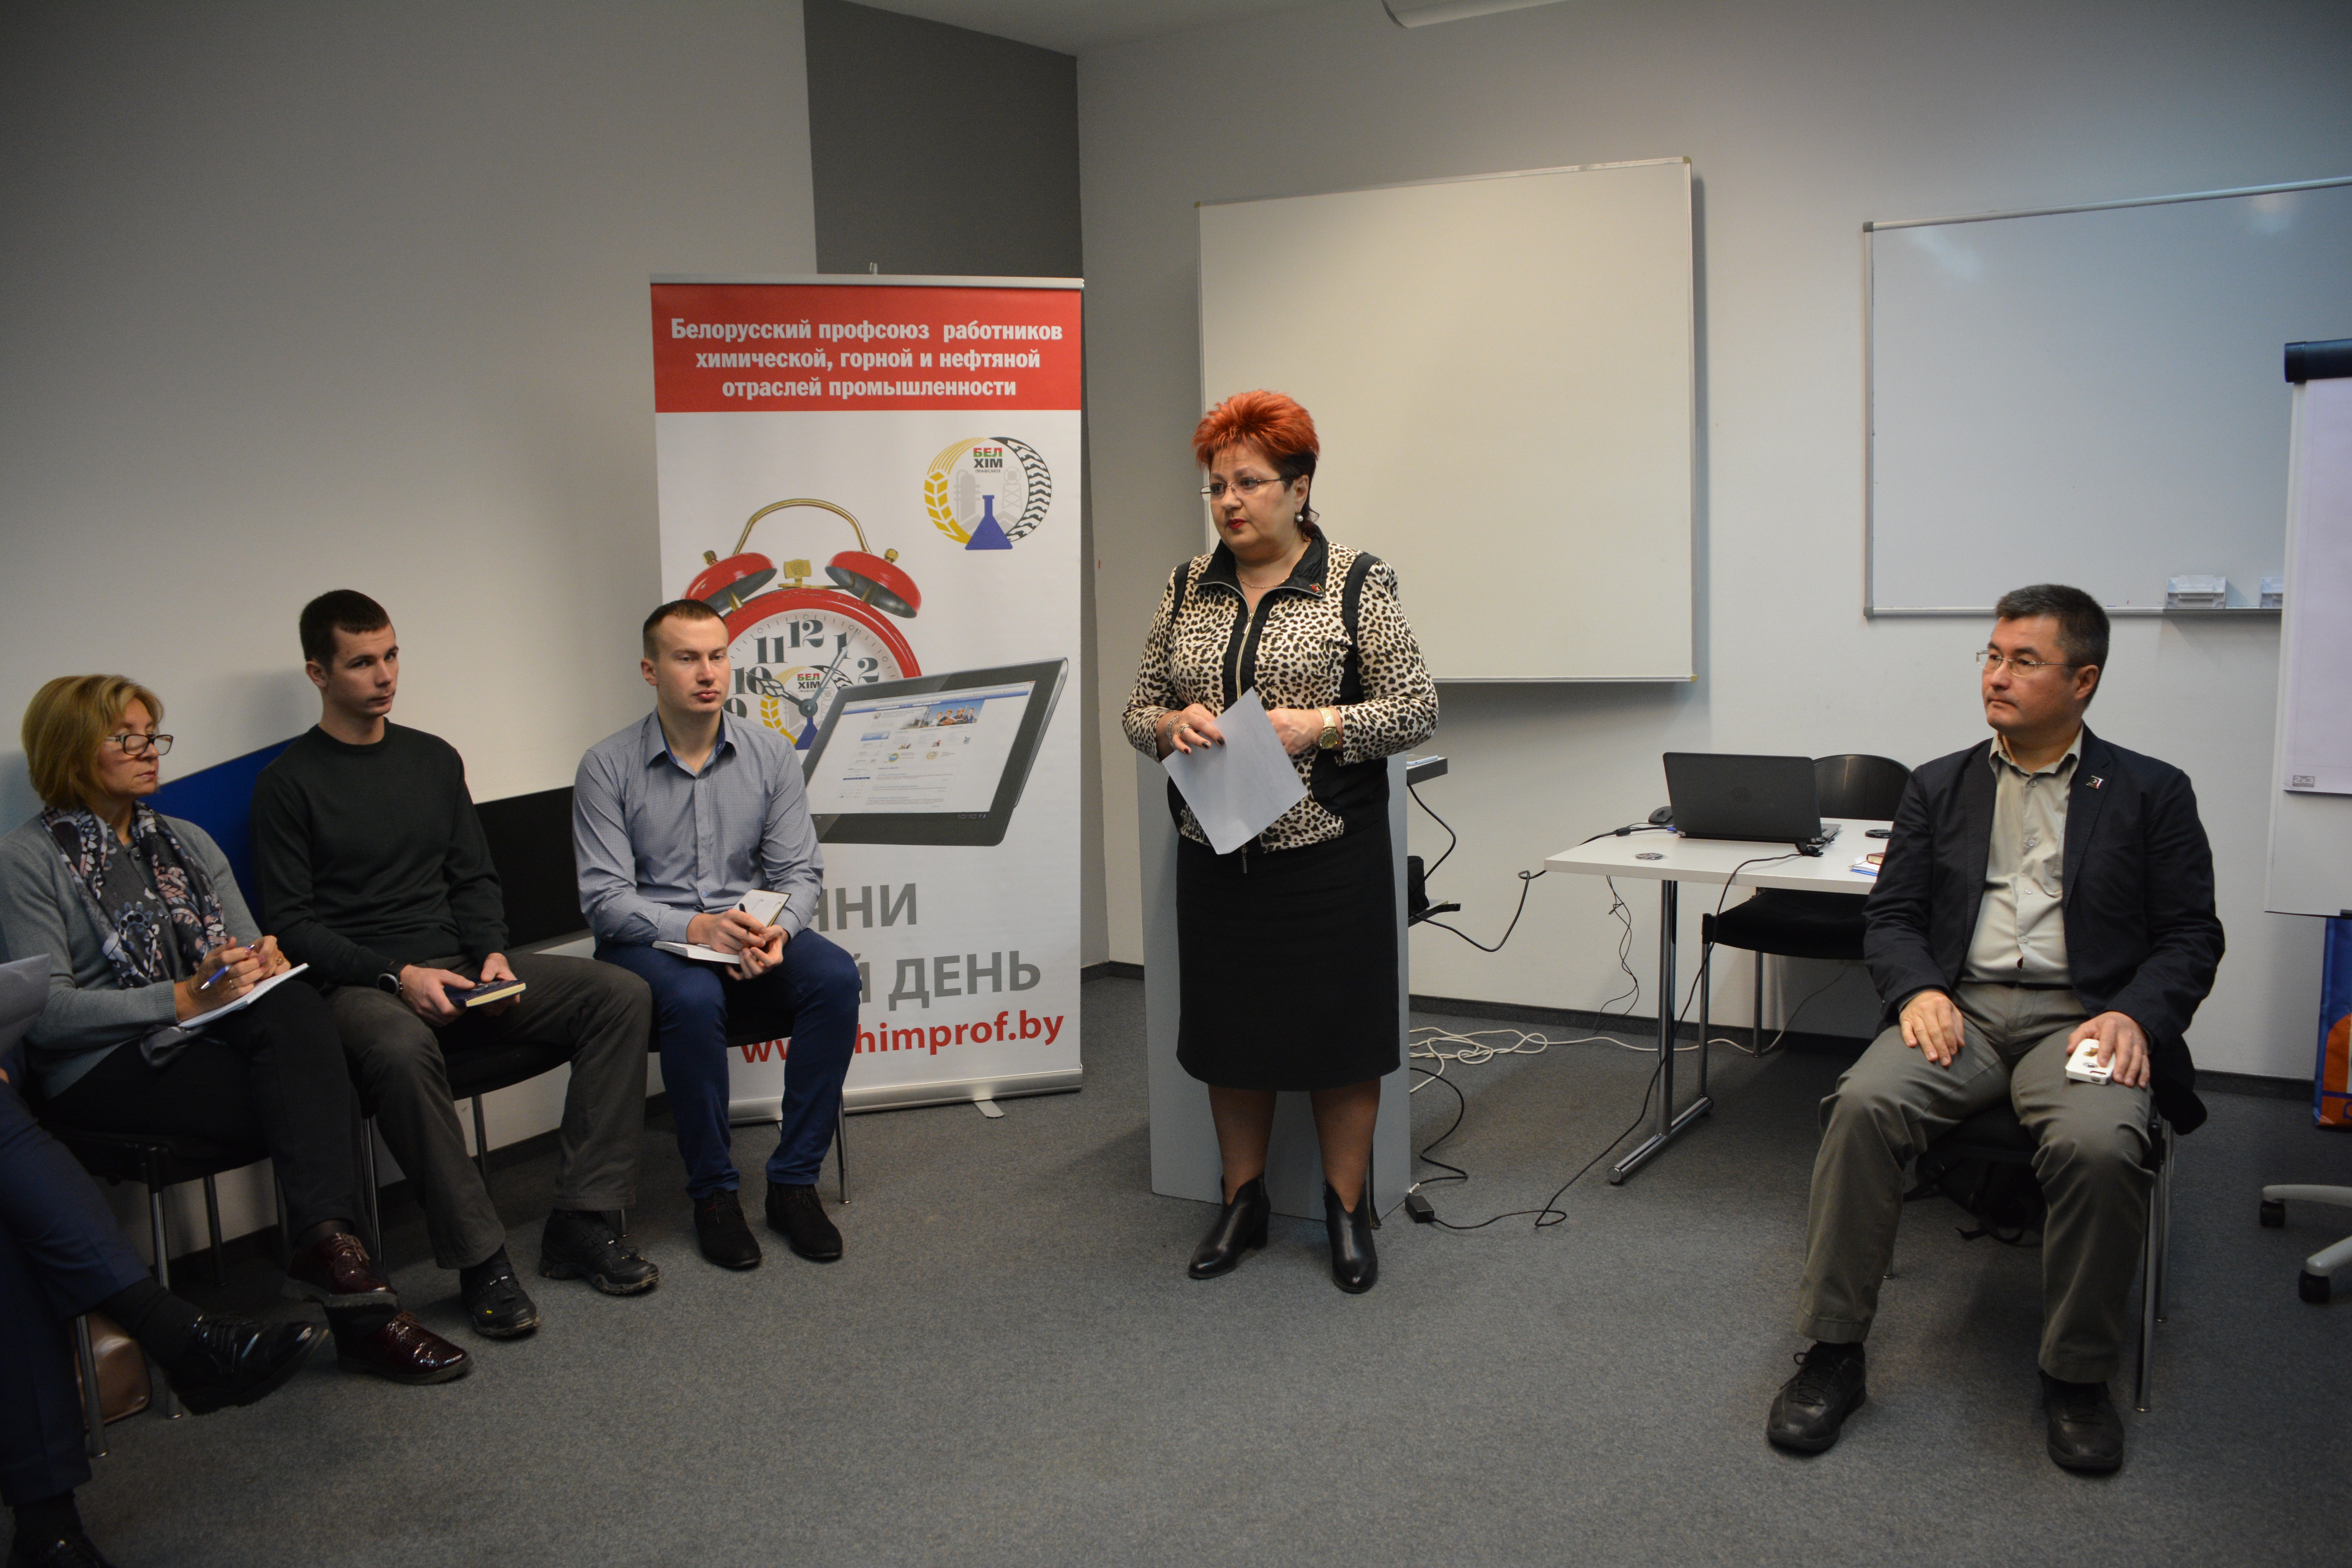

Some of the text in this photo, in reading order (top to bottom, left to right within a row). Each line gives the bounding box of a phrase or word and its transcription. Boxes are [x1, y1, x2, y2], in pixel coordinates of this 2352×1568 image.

[671, 318, 1063, 343] Белорусский профсоюз работников
[696, 348, 1040, 371] химической, горной и нефтяной
[722, 377, 1017, 400] отраслей промышленности
[973, 447, 1002, 457] БЕЛ
[786, 619, 824, 648] 12
[754, 635, 788, 664] 11
[731, 666, 772, 695] 10
[797, 673, 820, 681] БЕЛ
[857, 657, 879, 683] 2
[887, 951, 1041, 1011] ДЕНЬ
